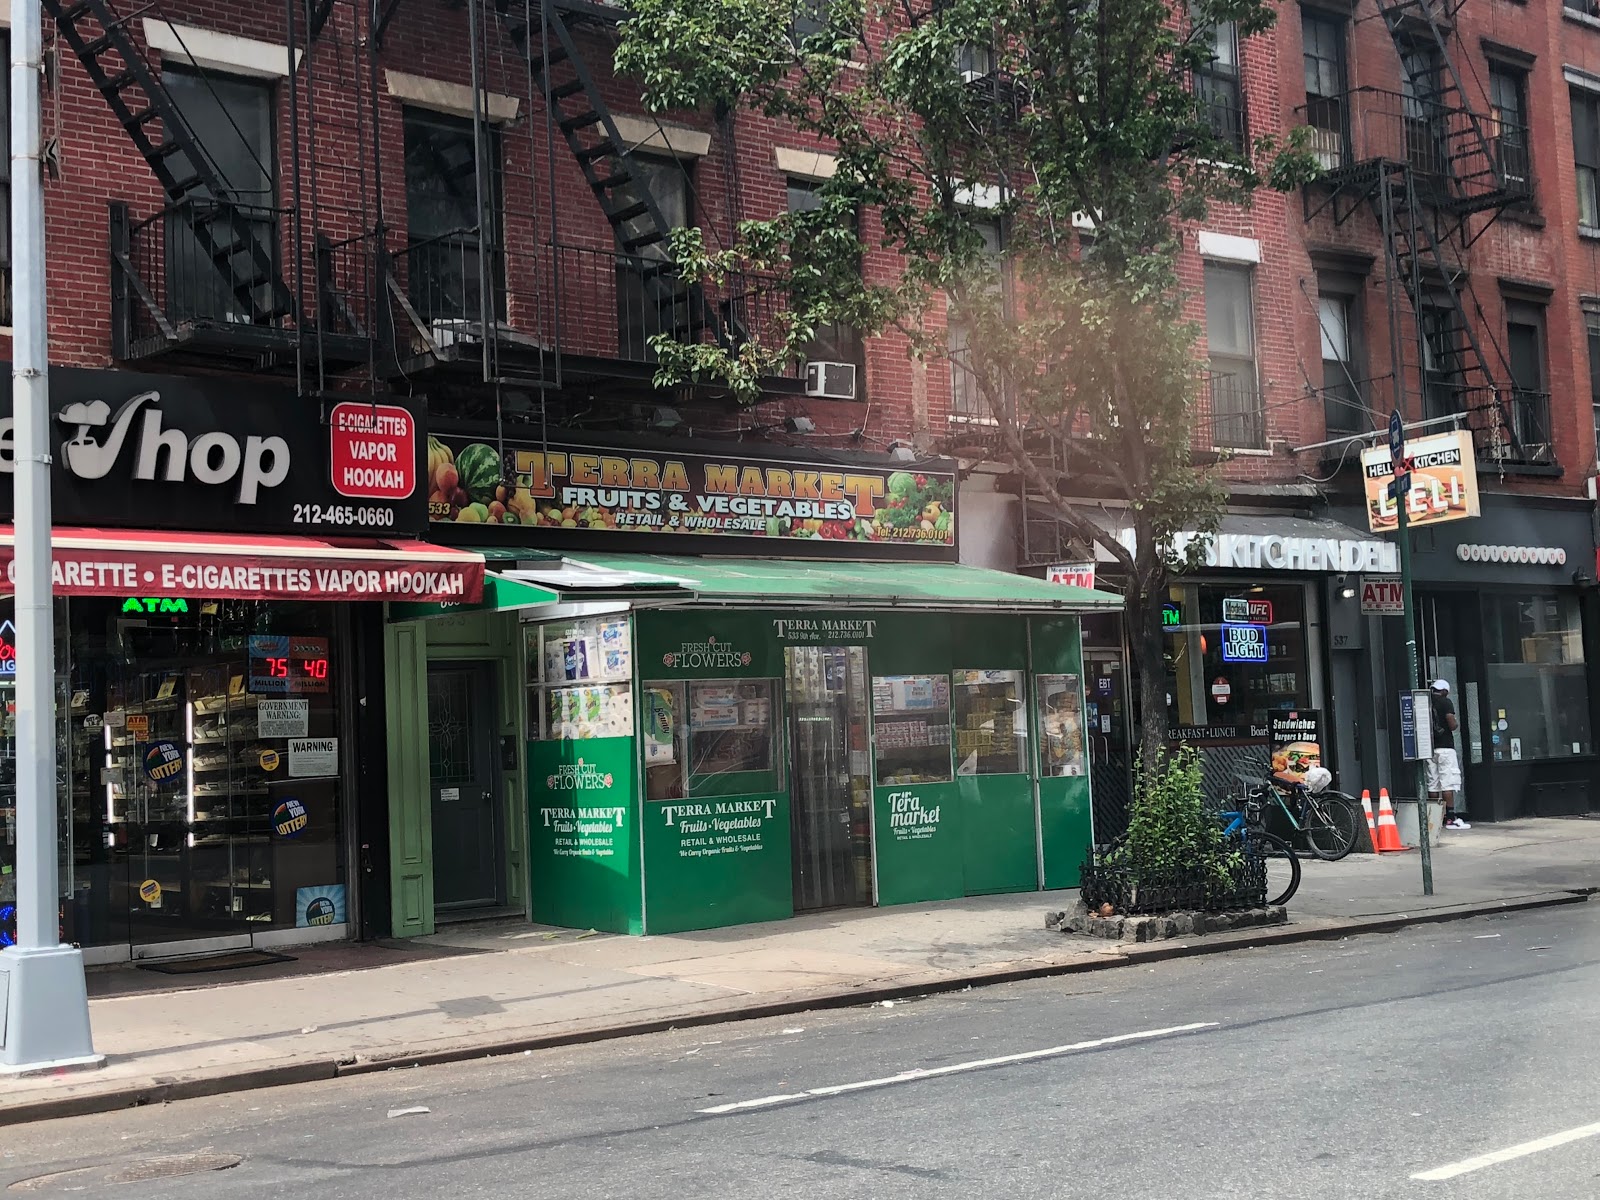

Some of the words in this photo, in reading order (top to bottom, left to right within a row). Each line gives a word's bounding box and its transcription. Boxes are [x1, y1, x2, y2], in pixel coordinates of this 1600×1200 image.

[338, 412, 407, 436] E-CIGARETTES
[349, 440, 397, 462] VAPOR
[1414, 449, 1459, 469] KITCHEN
[343, 467, 405, 489] HOOKAH
[515, 450, 690, 498] TERRA
[703, 464, 885, 518] MARKET
[428, 502, 451, 515] 533
[562, 486, 662, 510] FRUITS
[668, 493, 690, 511] &
[696, 495, 852, 520] VEGETABLES
[293, 504, 394, 527] 212-465-0660
[615, 512, 665, 527] RETAIL
[668, 514, 680, 527] &
[683, 515, 767, 532] WHOLESALE
[876, 526, 891, 537] Tel:
[893, 528, 948, 540] 212.736.0101
[1221, 534, 1341, 571] KITCHEN
[1341, 539, 1397, 573] DELI
[8, 561, 137, 587] ARETTE
[161, 564, 311, 592] E-CIGARETTES
[315, 568, 382, 593] VAPOR
[385, 570, 464, 595] HOOKAH
[1052, 573, 1093, 589] ATM
[1362, 584, 1404, 602] ATM
[122, 598, 188, 613] ATM
[1250, 604, 1268, 615] UFC
[1162, 610, 1179, 624] TM
[773, 619, 818, 638] TERRA
[822, 620, 876, 638] MARKET
[787, 632, 799, 640] 533
[1229, 627, 1258, 642] BUD
[681, 642, 710, 653] FRESH
[714, 642, 732, 652] CUT
[1334, 636, 1348, 645] 537
[1225, 642, 1264, 658] LIGHT
[266, 658, 287, 677] 75
[672, 651, 742, 668] FLOWERS
[304, 659, 327, 678] 40
[1099, 678, 1111, 689] EBT
[258, 701, 308, 711] GOVERNMENT
[266, 710, 301, 720] WARNING:
[654, 707, 670, 734] Bounty
[1273, 718, 1316, 730] Sandwiches
[1168, 728, 1205, 739] REAKFAST
[1210, 727, 1236, 738] LUNCH
[159, 743, 175, 752] NEW
[292, 741, 334, 753] WARNING
[1512, 743, 1520, 755] A
[162, 749, 180, 762] YORK
[149, 758, 183, 780] LOTTERY
[558, 765, 580, 775] FRESH
[581, 763, 597, 774] CUT
[553, 773, 605, 790] FLOWERS
[286, 800, 300, 809] NEW
[289, 805, 306, 818] YORK
[541, 807, 576, 827] TERRA
[578, 806, 626, 827] MARKET
[661, 803, 712, 827] TERRA
[715, 799, 777, 819] MARKET
[890, 805, 941, 827] market
[276, 813, 308, 835] LOTTERY
[553, 820, 573, 833] Fruits
[575, 820, 613, 837] Vegetables
[680, 820, 708, 834] Fruits
[711, 815, 761, 834] Vegetables
[555, 838, 573, 846] RETAIL
[574, 838, 578, 846] &
[579, 838, 613, 846] WHOLESALE
[680, 837, 707, 847] RETAIL
[708, 837, 714, 845] &
[715, 833, 761, 844] WHOLESALE
[688, 849, 702, 857] Carry
[702, 847, 721, 857] Organic
